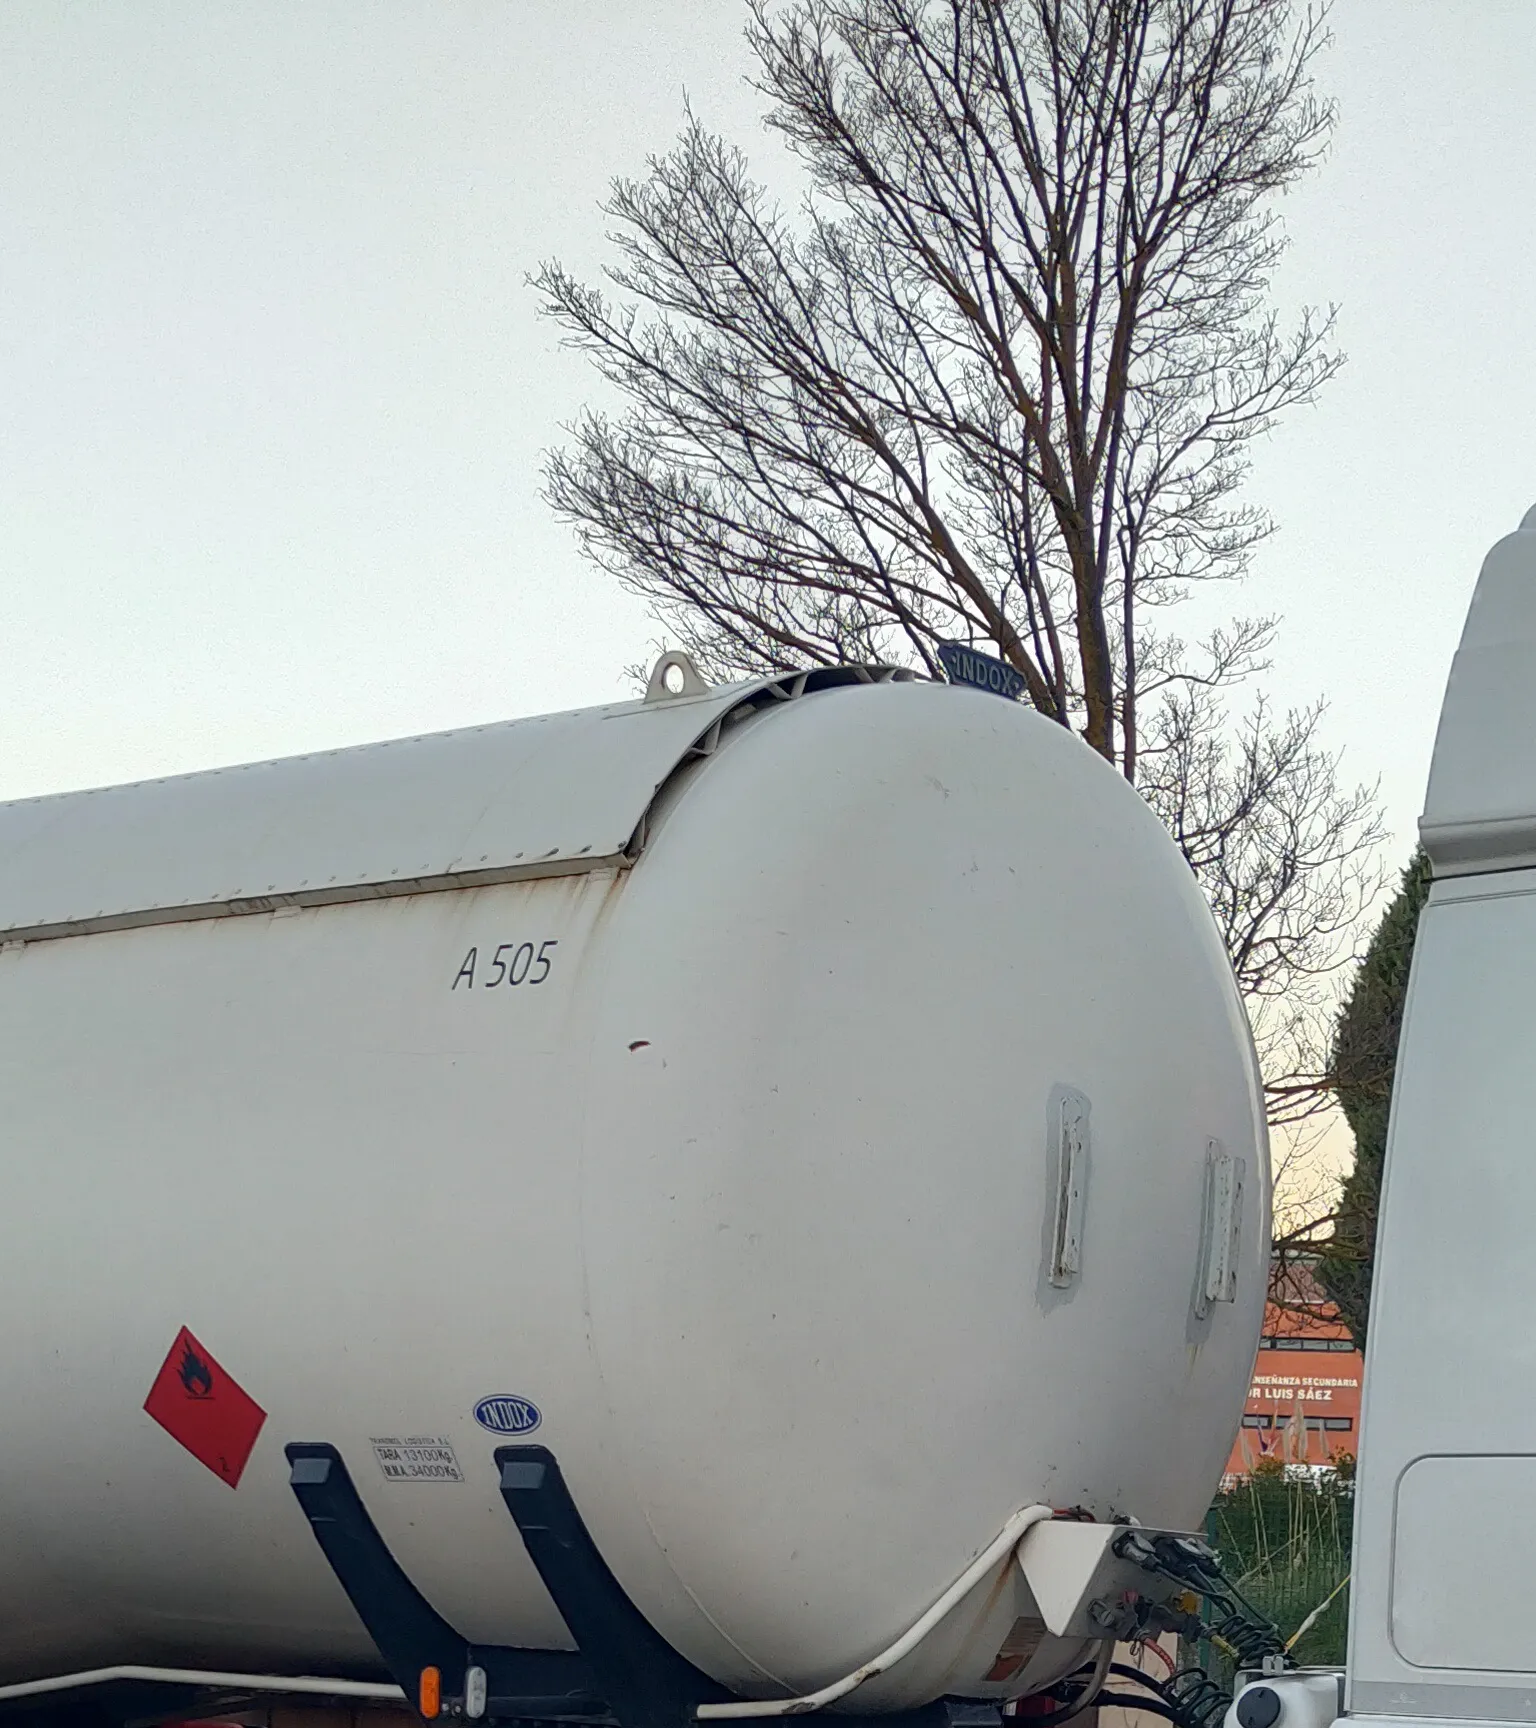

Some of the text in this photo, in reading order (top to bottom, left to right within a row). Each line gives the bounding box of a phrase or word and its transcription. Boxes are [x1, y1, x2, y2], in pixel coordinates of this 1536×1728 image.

[953, 650, 1014, 698] INDOX
[451, 940, 559, 990] A 505
[1302, 1377, 1359, 1387] SECUNDARIA
[1265, 1389, 1294, 1400] LUIS
[1297, 1386, 1333, 1400] SÁEZ
[481, 1401, 534, 1430] INDOX
[376, 1449, 403, 1461] TARA
